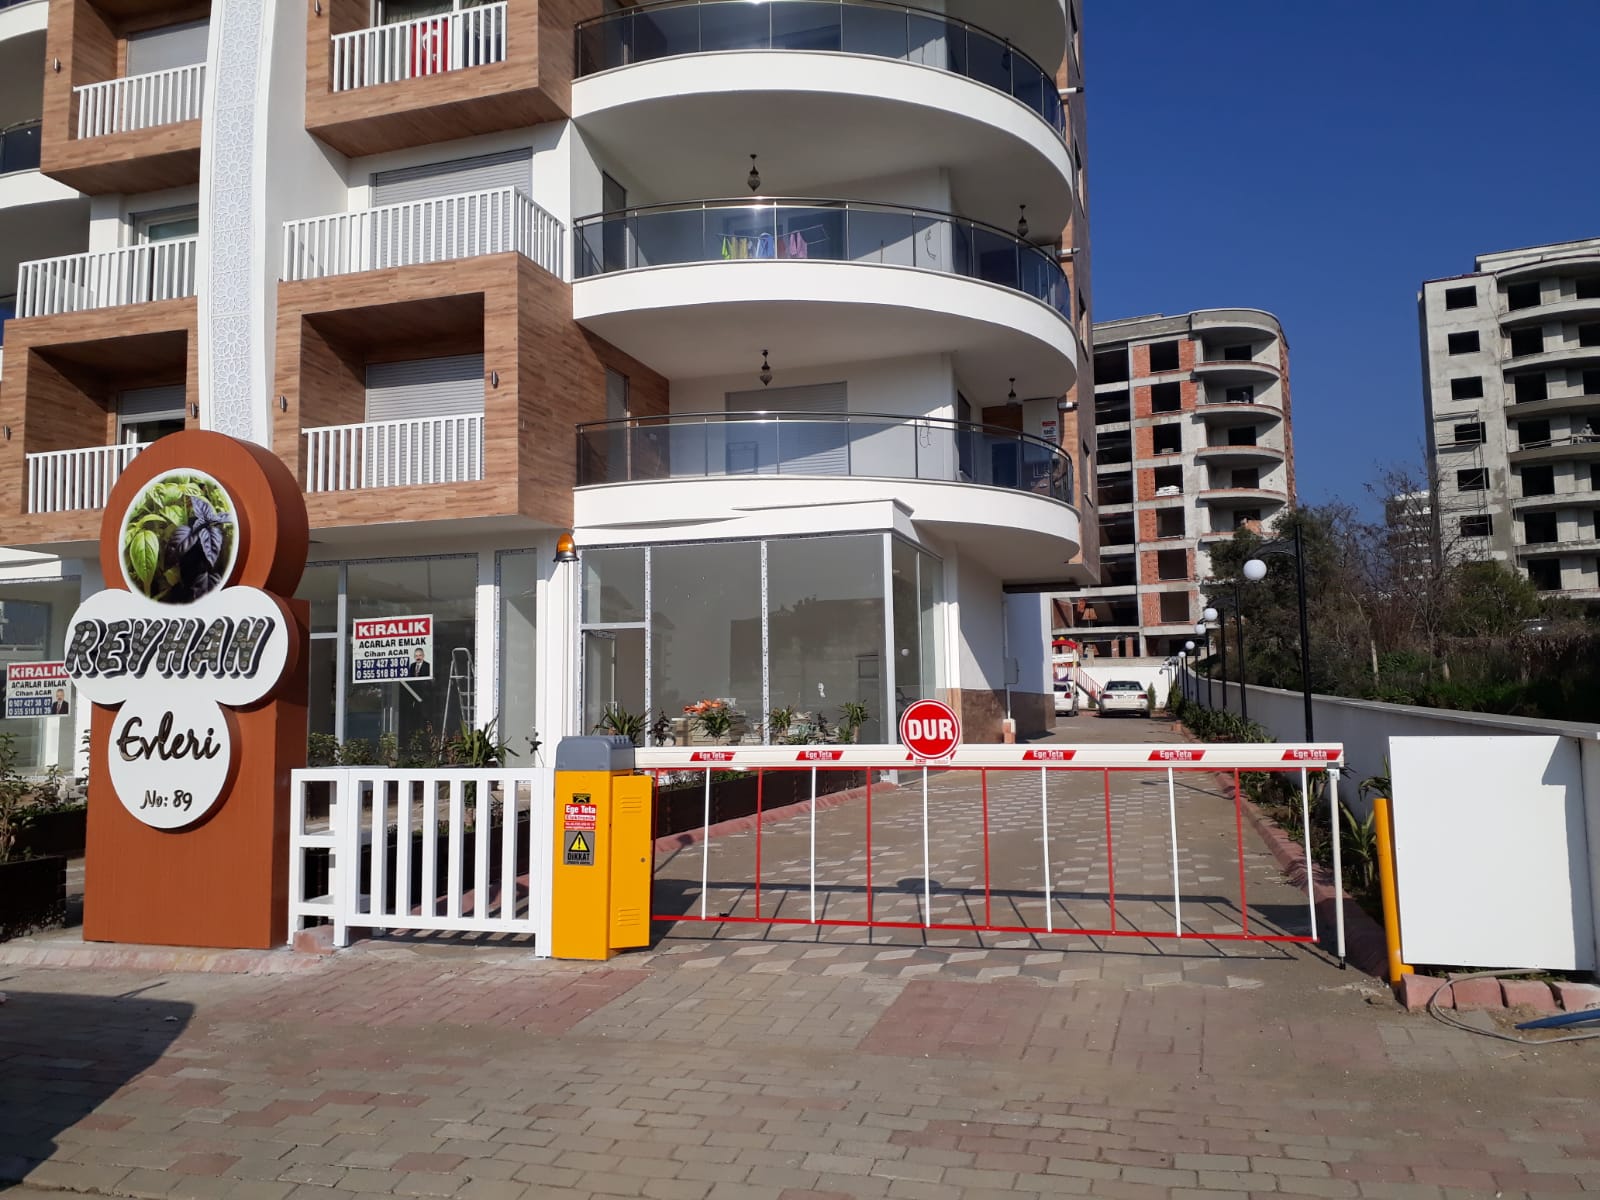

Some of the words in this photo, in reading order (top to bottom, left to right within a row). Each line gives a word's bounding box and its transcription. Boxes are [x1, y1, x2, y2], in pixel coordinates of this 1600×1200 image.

[64, 616, 276, 679] REYHAN
[359, 639, 396, 649] ACARLAR
[398, 637, 426, 646] EMLAK
[356, 661, 361, 669] 0
[362, 660, 375, 669] 507
[400, 658, 409, 667] 07
[356, 671, 361, 679] 0
[362, 670, 375, 678] 555
[376, 669, 389, 678] 518
[390, 669, 398, 677] 81
[400, 668, 409, 677] 39
[11, 681, 42, 689] ACARLAR
[908, 718, 954, 741] DUR
[116, 711, 221, 761] Evleri
[1160, 750, 1174, 759] Ege
[1294, 750, 1308, 759] Ege
[140, 790, 168, 809] No:
[173, 790, 193, 811] 89
[566, 805, 579, 814] Ege
